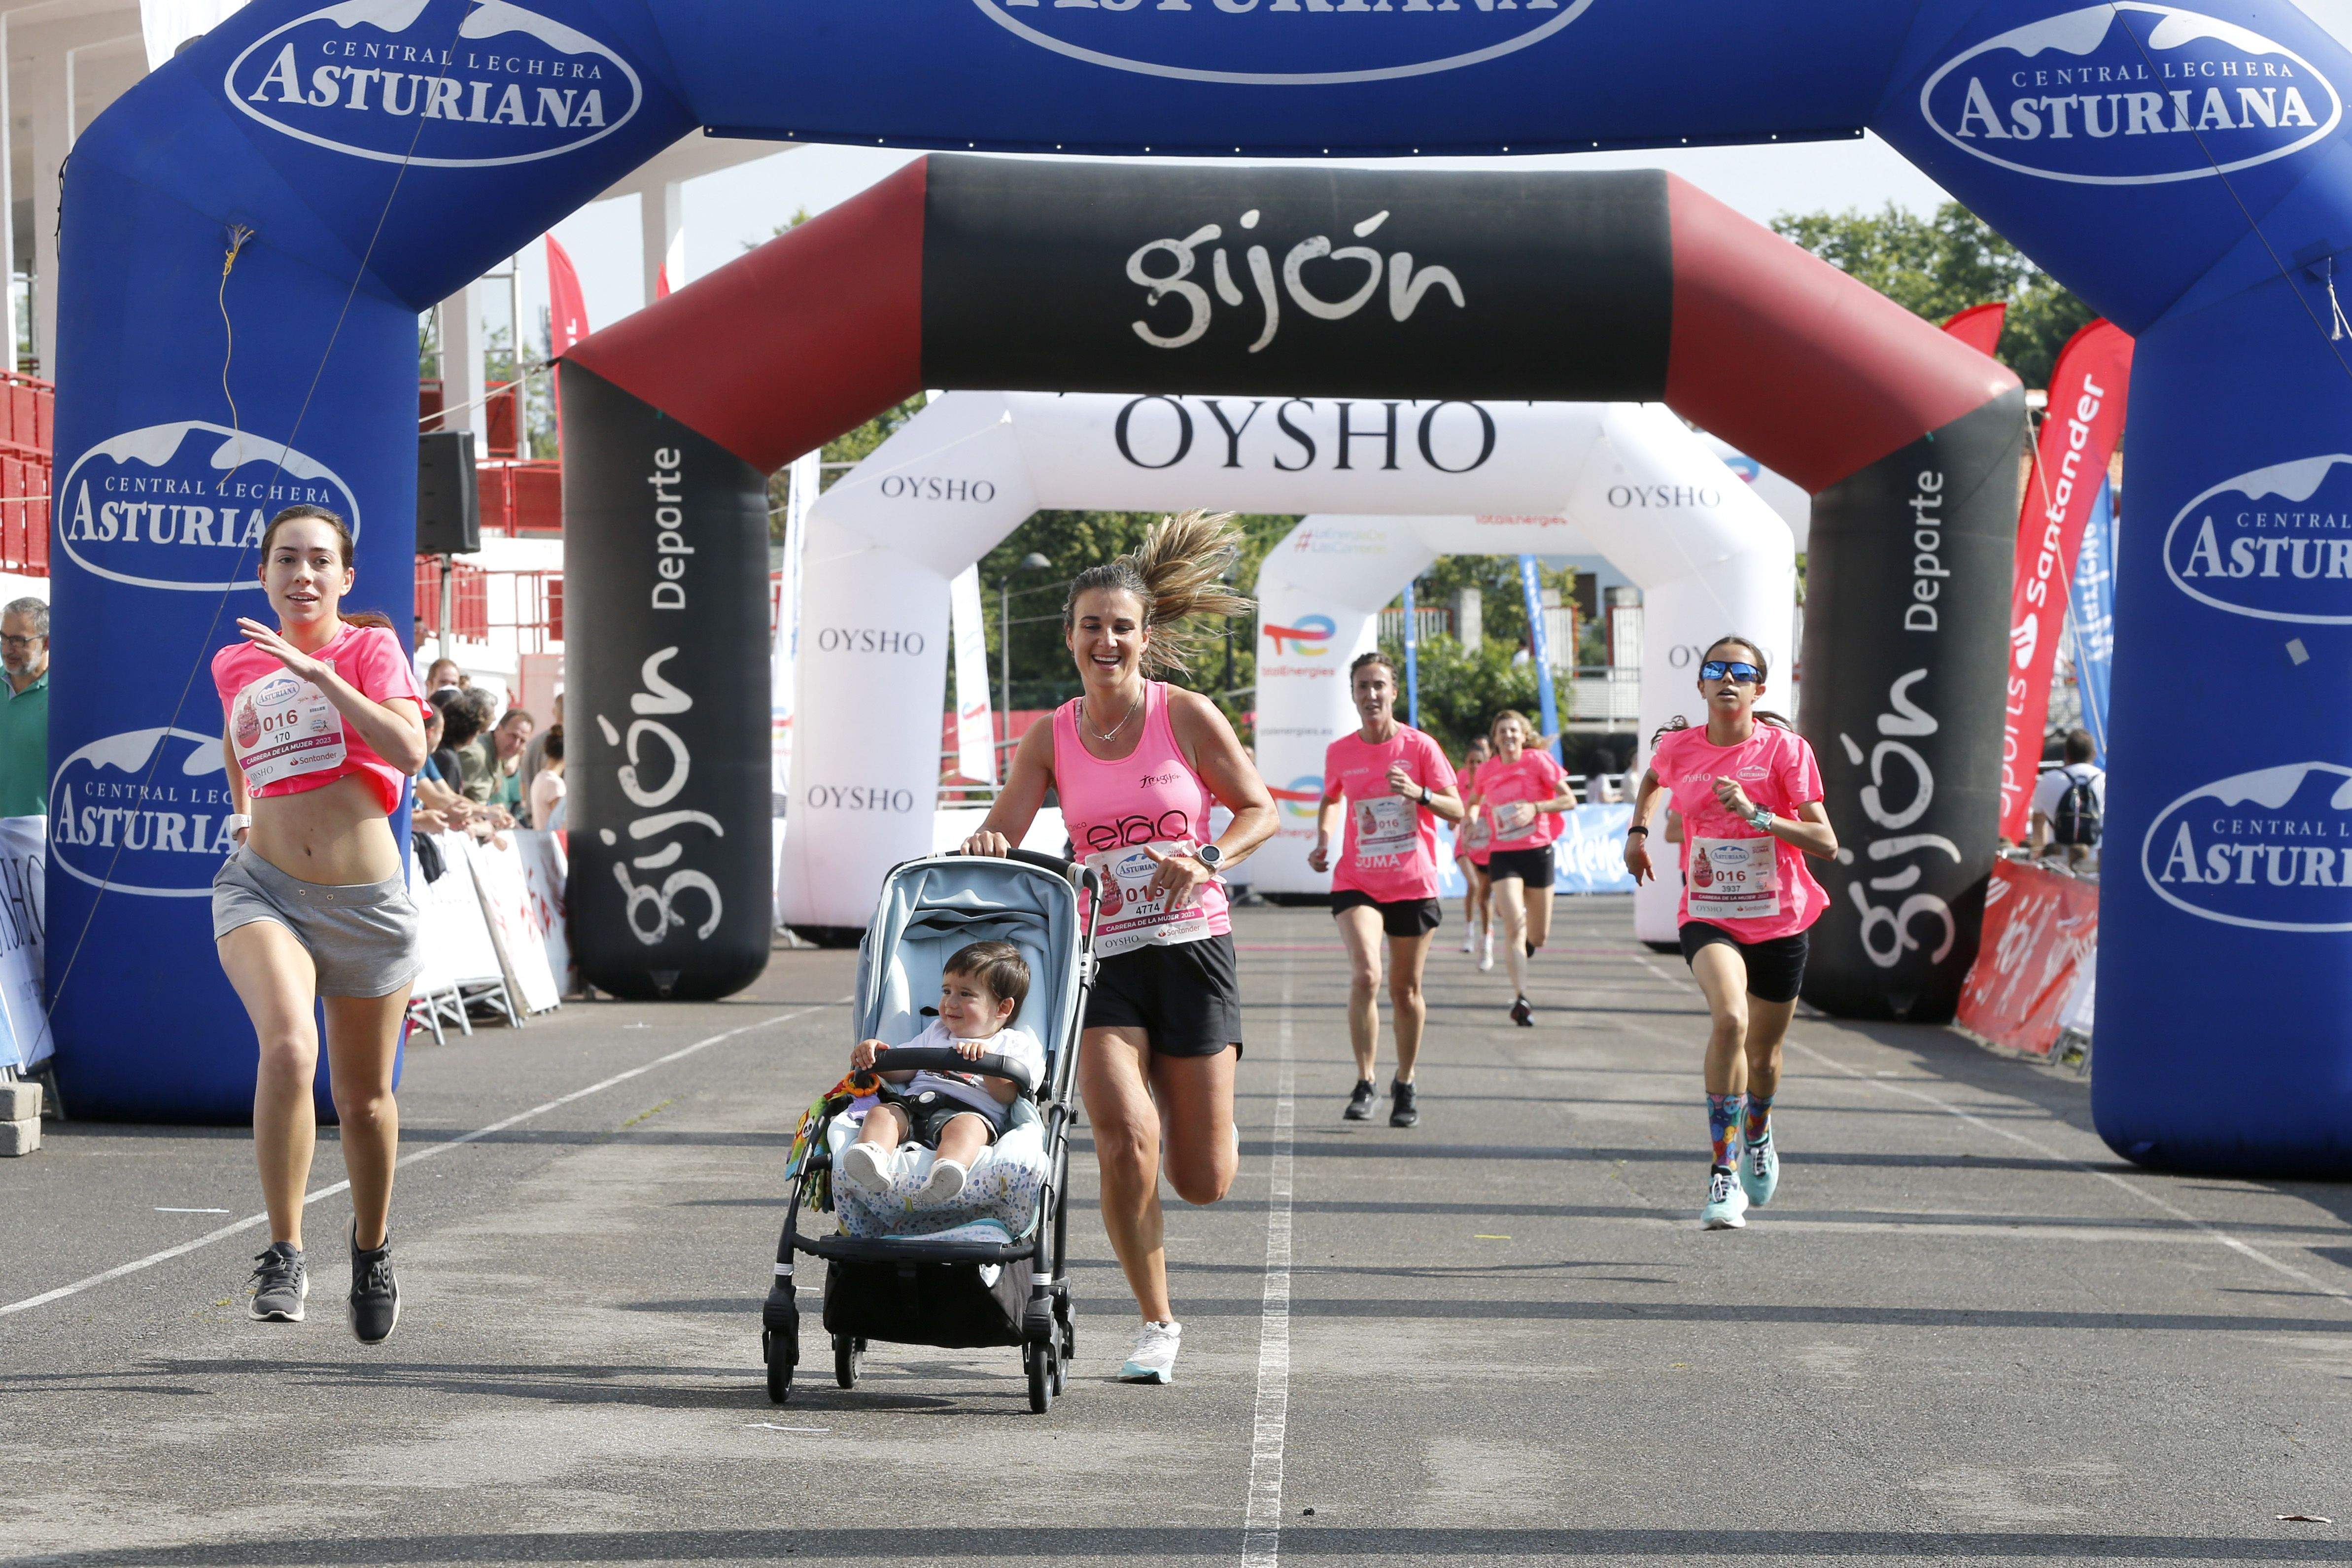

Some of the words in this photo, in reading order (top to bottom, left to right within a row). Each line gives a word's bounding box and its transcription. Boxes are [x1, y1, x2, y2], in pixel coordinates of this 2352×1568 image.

[322, 40, 452, 66] CENTRAL
[468, 52, 602, 79] LECHERA
[248, 42, 606, 128] ASTURIANA
[2012, 65, 2148, 87] CENTRAL
[2164, 61, 2294, 78] LECHERA
[1956, 77, 2317, 140] ASTURIANA
[1126, 209, 1465, 353] gijón
[1115, 394, 1496, 473] OYSHO
[105, 476, 206, 495] CENTRAL
[219, 482, 330, 503] LECHERA
[881, 475, 996, 504] OYSHO
[1608, 485, 1720, 509] OYSHO
[2026, 373, 2104, 607] Santander
[68, 479, 267, 548] ASTURIA
[2237, 513, 2351, 528] CENTRAL
[648, 448, 694, 610] Deporte
[818, 627, 925, 656] OYSHO
[259, 687, 297, 703] ASTURIANA
[263, 709, 298, 732] 016
[1837, 669, 1961, 968] gijón
[1904, 470, 1950, 631] Deporte
[275, 732, 290, 743] 170
[246, 752, 271, 765] CARRERA
[290, 740, 313, 751] MUJER
[315, 737, 331, 745] 2023
[300, 752, 337, 764] Santander
[250, 766, 273, 781] OYSHO
[86, 781, 178, 802] CENTRAL
[597, 646, 724, 945] gijón
[808, 784, 914, 813] OYSHO
[55, 783, 233, 854] ASTURIA
[1380, 819, 1398, 829] 016
[2213, 820, 2326, 836] CENTRAL
[1120, 863, 1158, 874] ASTURIAN
[1716, 871, 1746, 881] 016
[1136, 903, 1160, 915] 4774
[1106, 922, 1136, 932] CARRERA
[1158, 913, 1179, 922] MUJER
[1167, 925, 1200, 936] Santander
[1106, 935, 1139, 948] OYSHO
